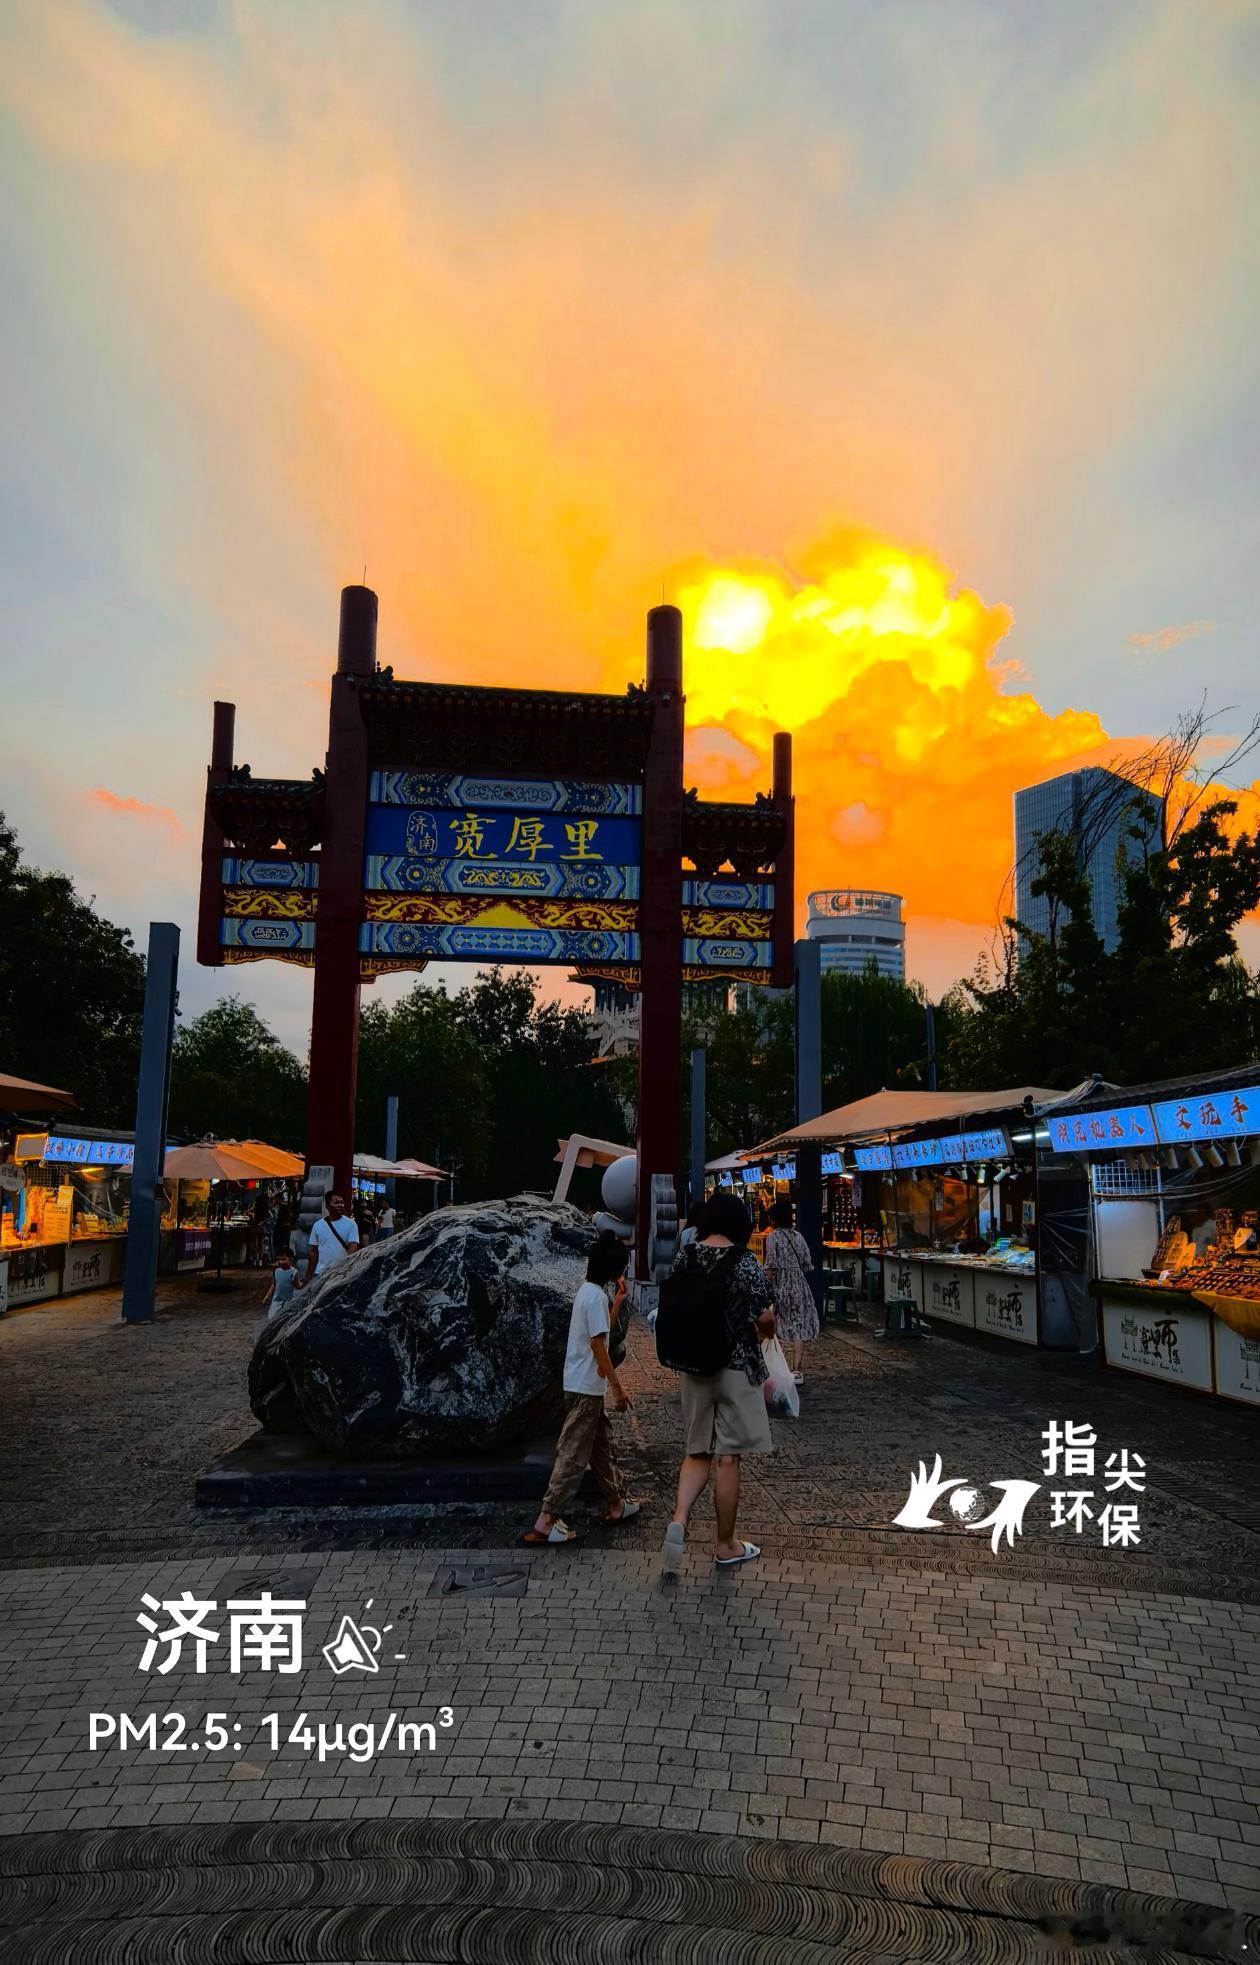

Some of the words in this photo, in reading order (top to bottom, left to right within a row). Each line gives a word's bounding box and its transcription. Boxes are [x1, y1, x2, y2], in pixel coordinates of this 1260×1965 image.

[410, 814, 436, 852] 济南
[449, 812, 605, 861] 宽厚里
